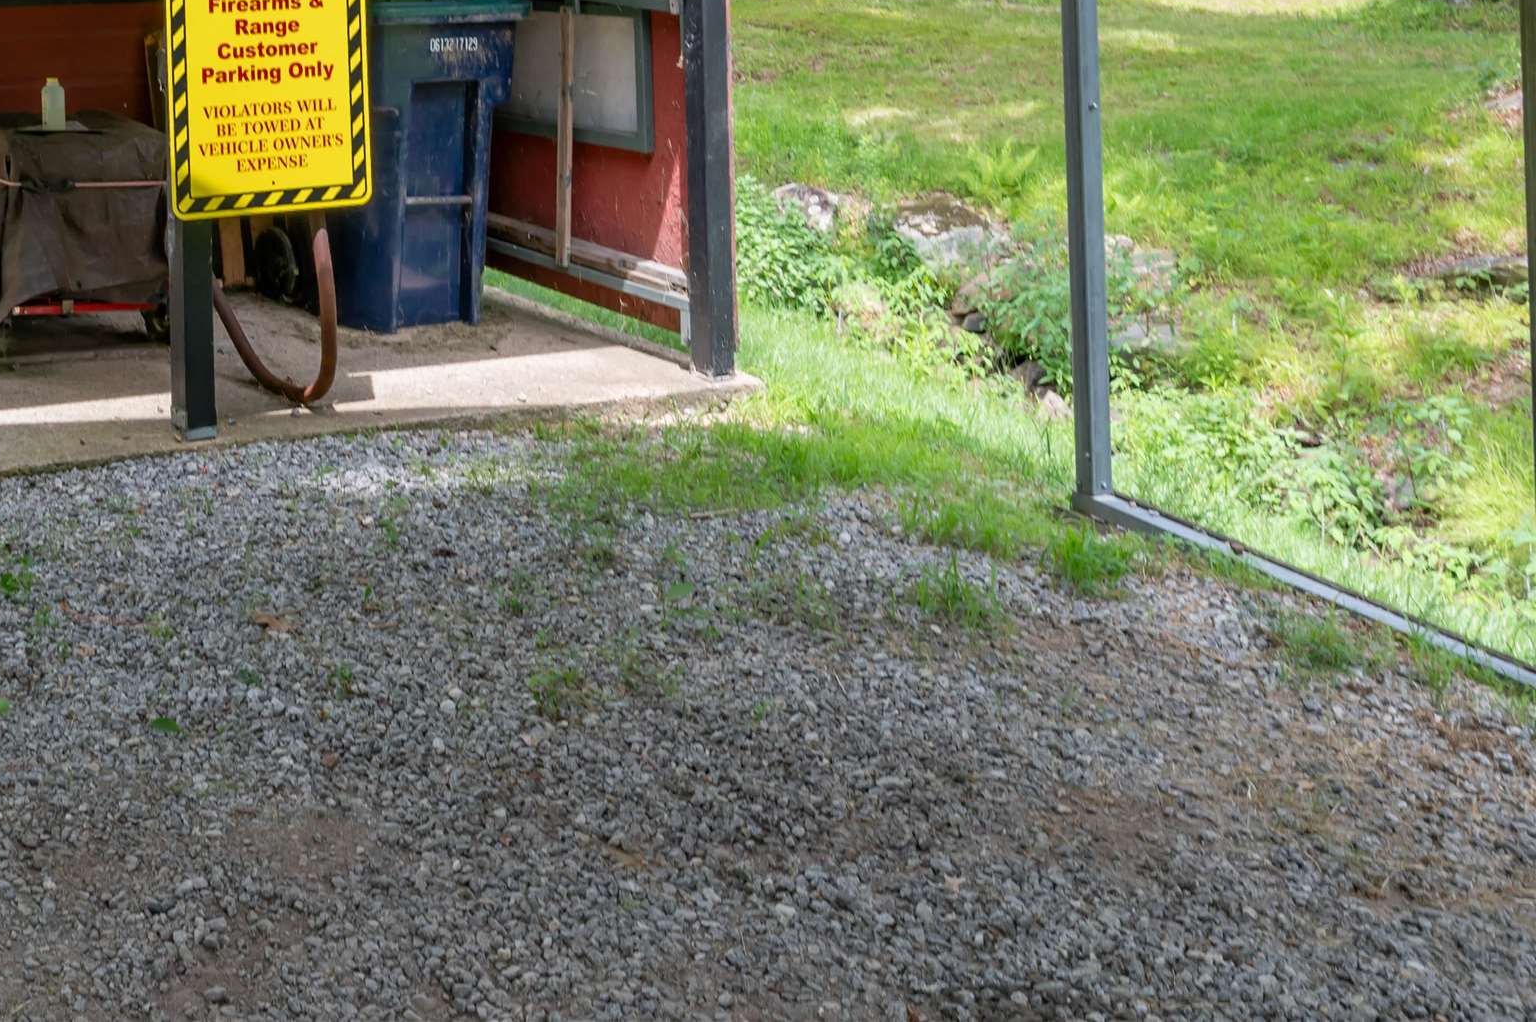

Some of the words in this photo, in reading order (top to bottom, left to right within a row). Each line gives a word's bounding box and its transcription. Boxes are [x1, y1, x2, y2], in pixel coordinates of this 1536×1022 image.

[235, 18, 301, 38] Range
[217, 41, 319, 60] Customer
[201, 64, 282, 85] Parking
[288, 60, 335, 82] Only
[202, 100, 293, 120] VIOLATORS
[297, 97, 338, 114] WILL
[216, 122, 238, 139] BE
[242, 118, 301, 136] TOWED
[304, 116, 326, 132] AT
[198, 139, 269, 158] VEHICLE
[273, 134, 344, 152] OWNER'S
[236, 154, 308, 173] EXPENSE
